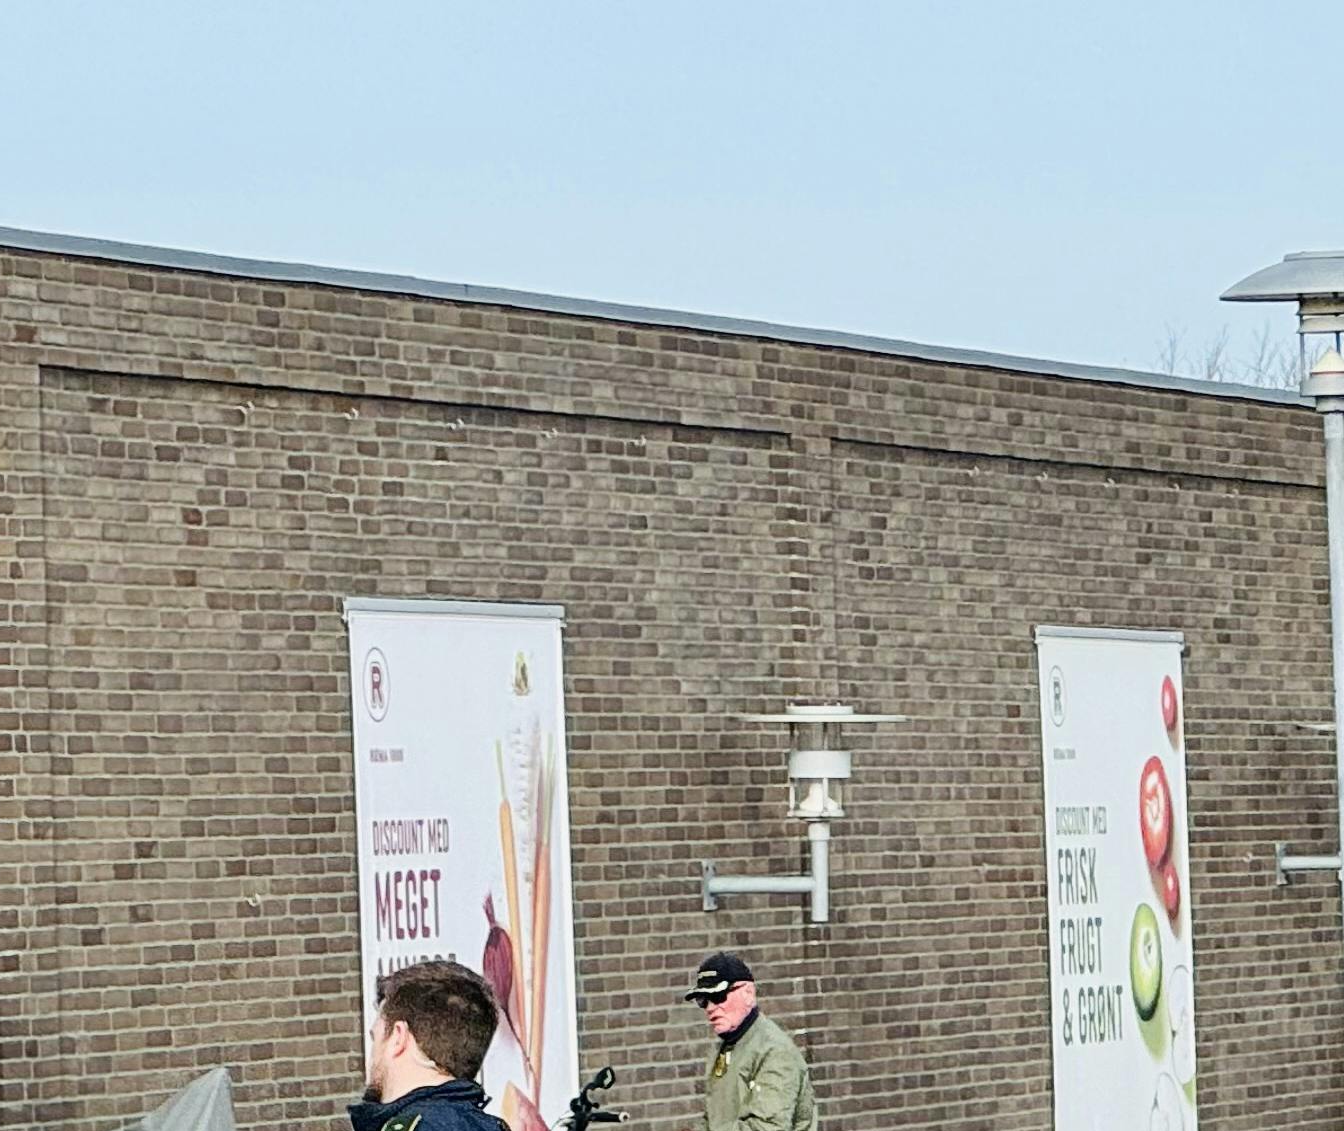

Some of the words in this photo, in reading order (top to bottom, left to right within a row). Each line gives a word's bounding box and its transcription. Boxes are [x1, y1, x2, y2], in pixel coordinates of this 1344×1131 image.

[372, 819, 424, 856] DISCOUNT
[428, 818, 450, 854] MED
[375, 868, 441, 942] MEGET
[1057, 847, 1098, 906] FRISK
[1060, 917, 1103, 975] FRUGT
[1063, 987, 1074, 1046] &
[1077, 984, 1123, 1045] GRØNT
